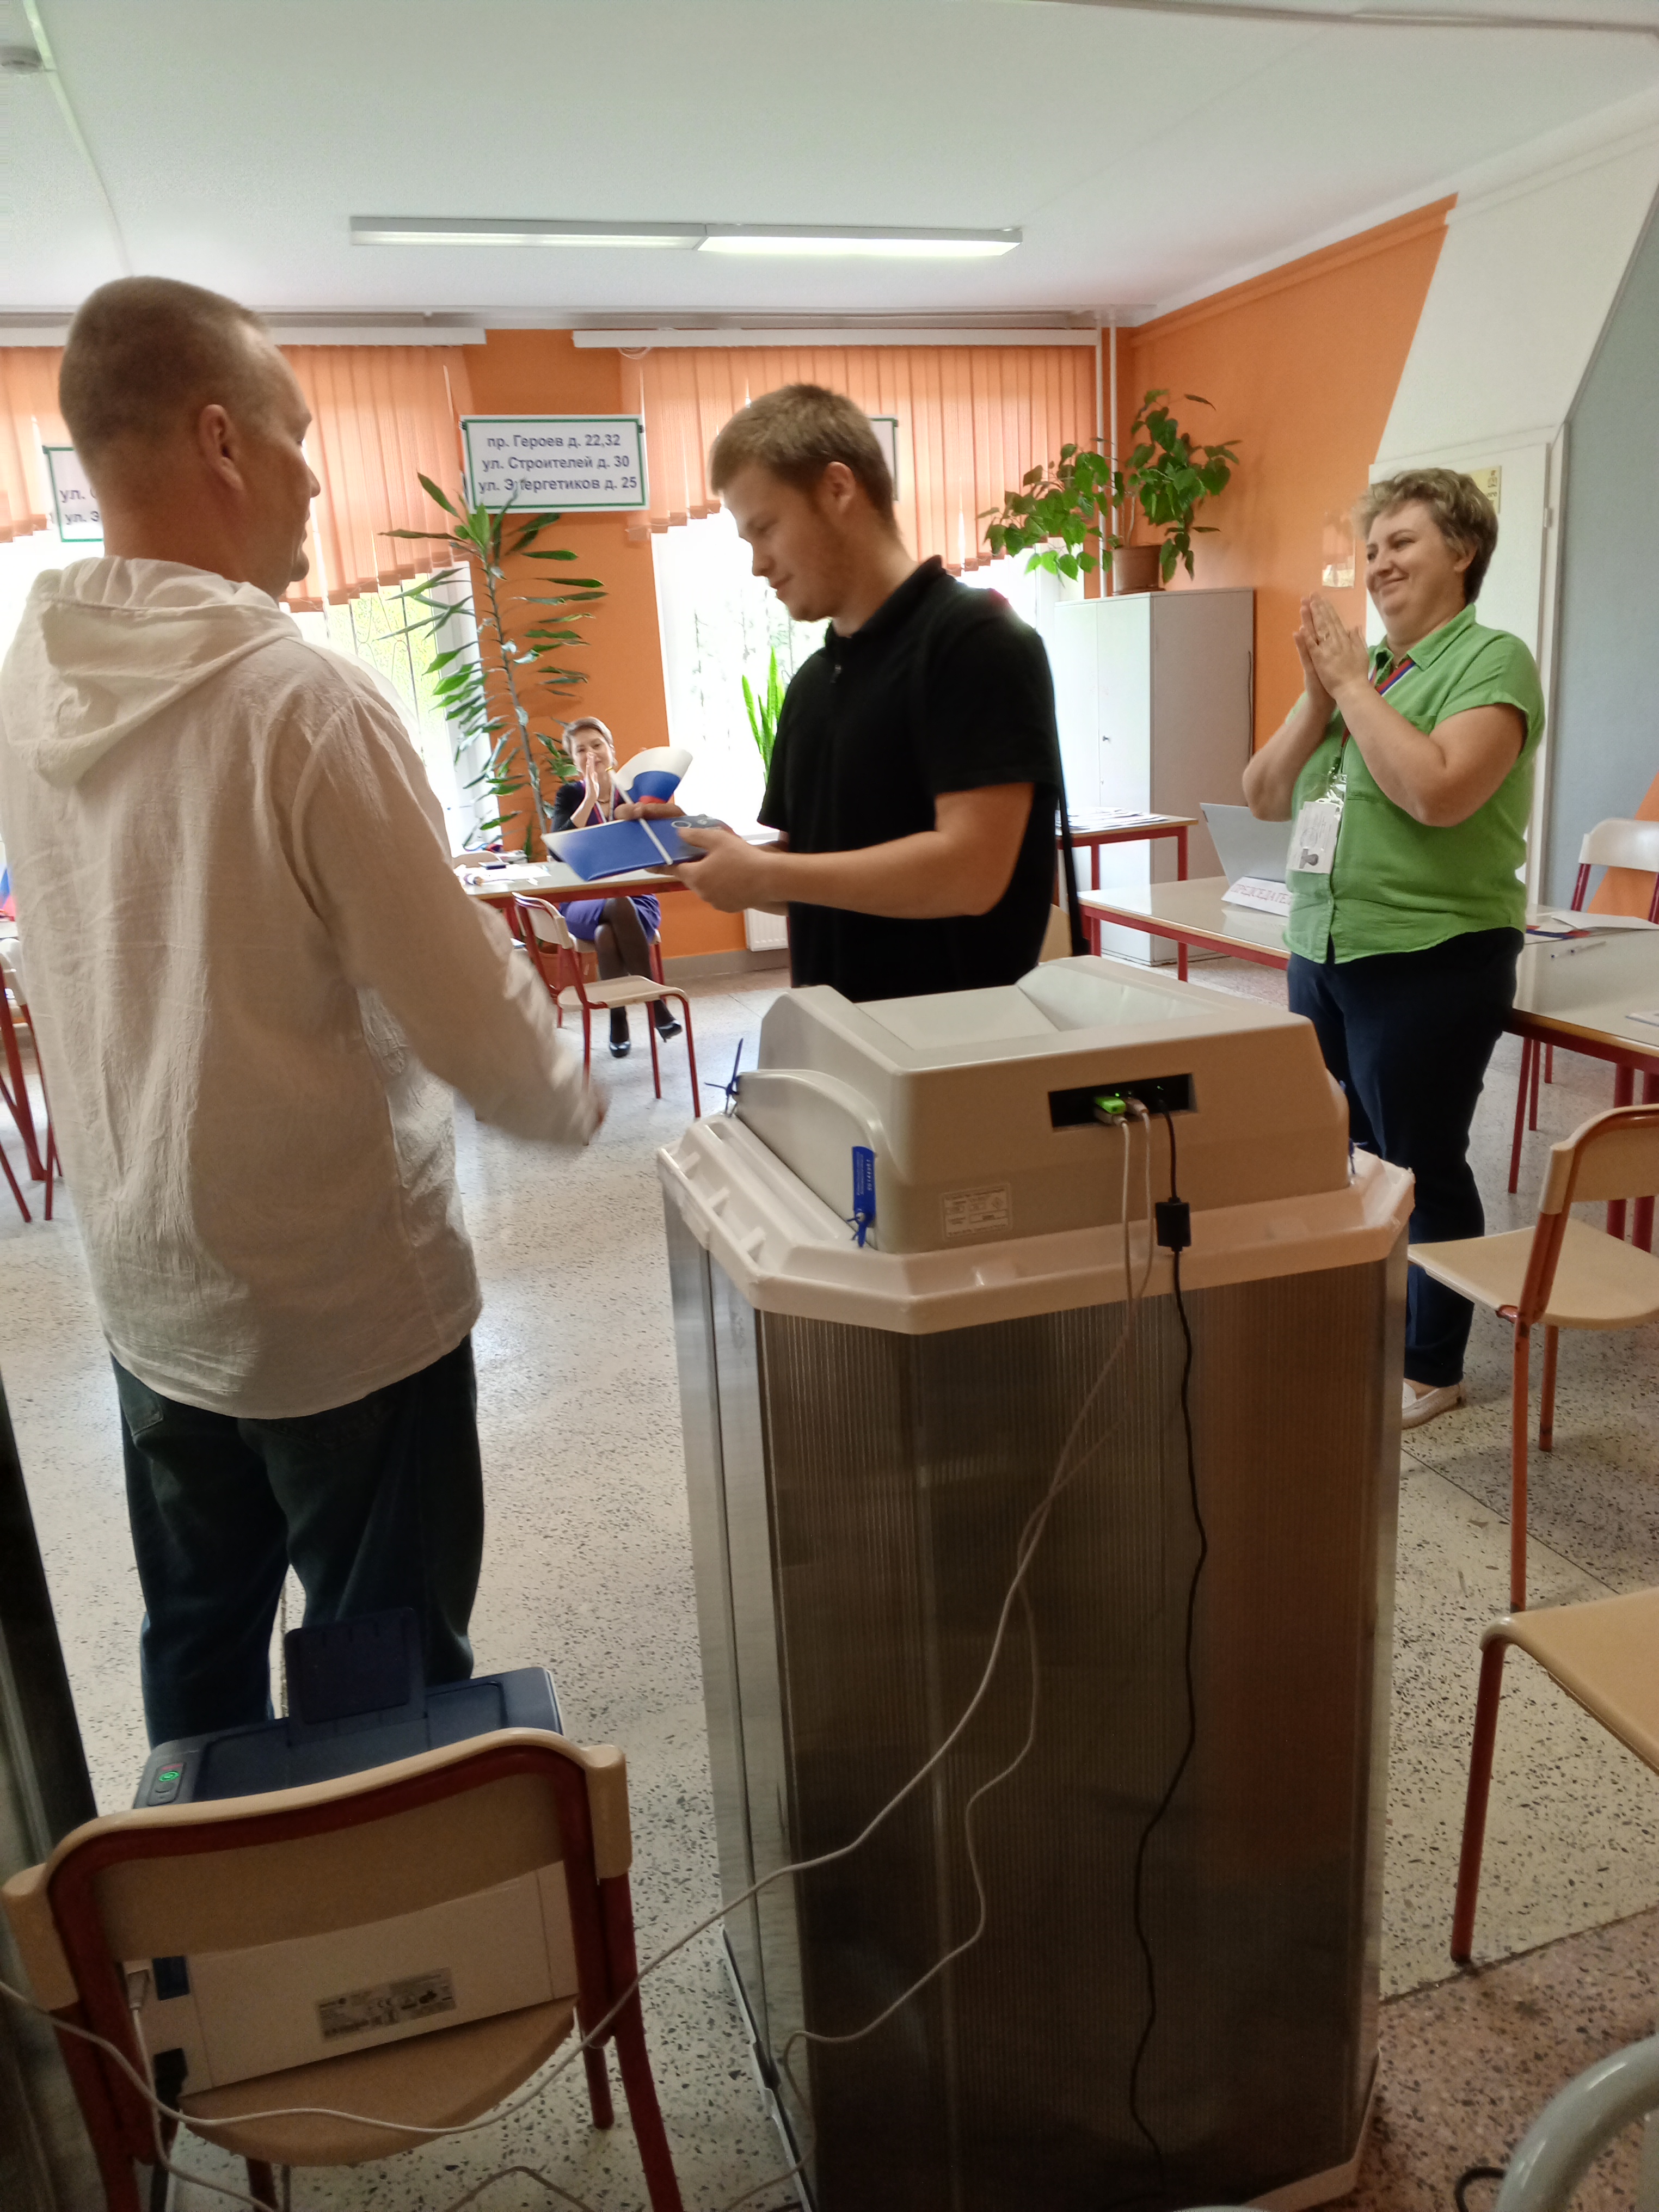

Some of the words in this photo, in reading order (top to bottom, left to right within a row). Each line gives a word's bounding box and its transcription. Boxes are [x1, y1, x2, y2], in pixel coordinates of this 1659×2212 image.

[487, 437, 509, 451] пр.
[513, 434, 564, 450] Героев
[568, 437, 581, 448] д.
[585, 434, 621, 448] 22,32
[481, 459, 504, 472] ул.
[508, 456, 593, 472] Строителей
[597, 458, 610, 469] д.
[613, 455, 630, 468] 30
[478, 481, 500, 494] ул.
[604, 479, 617, 490] д.
[621, 476, 637, 489] 25
[59, 490, 86, 503] ул.
[65, 513, 87, 525] ул.
